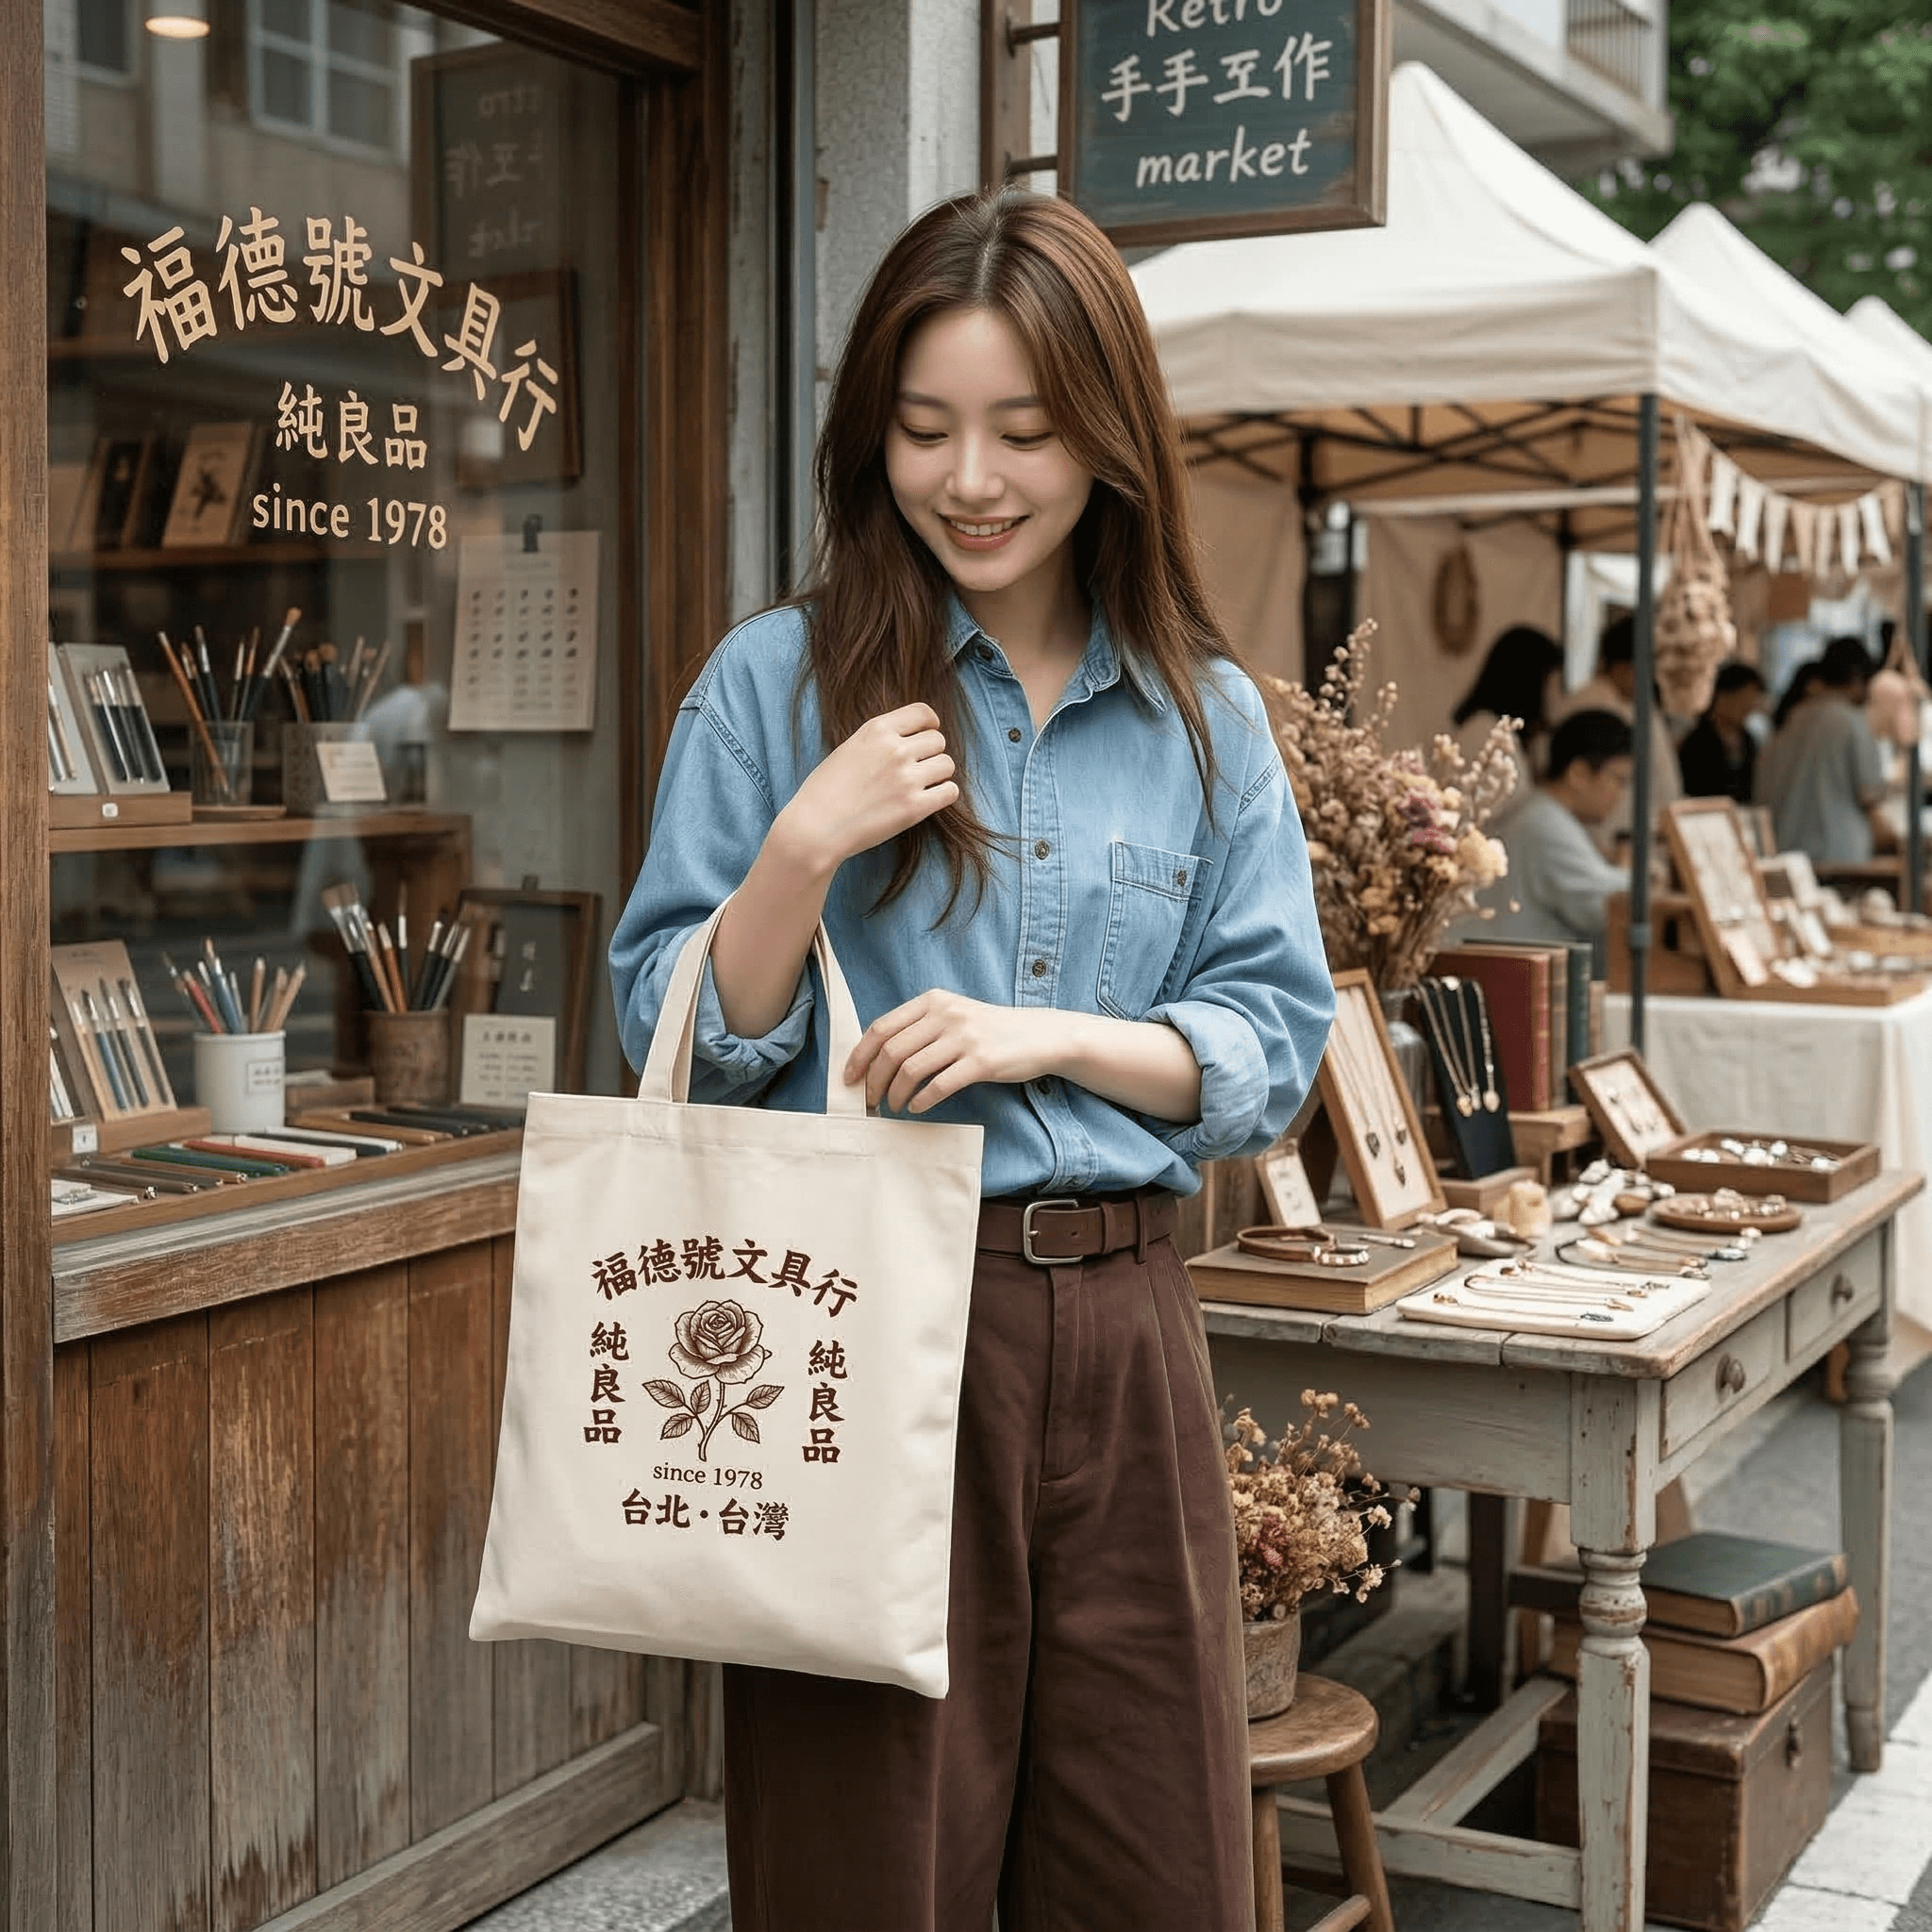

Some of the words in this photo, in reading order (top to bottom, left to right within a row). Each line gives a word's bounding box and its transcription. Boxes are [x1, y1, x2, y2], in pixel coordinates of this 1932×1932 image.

[1136, 125, 1312, 188] market
[121, 207, 558, 451] 福德號文具行
[275, 381, 427, 470] 純良品
[252, 482, 350, 538] since
[366, 496, 447, 549] 1978
[591, 1235, 858, 1318] 福德號文具行
[583, 1321, 630, 1444] 純良品
[802, 1340, 848, 1464] 純良品
[652, 1461, 708, 1484] since
[712, 1467, 763, 1491] 1978
